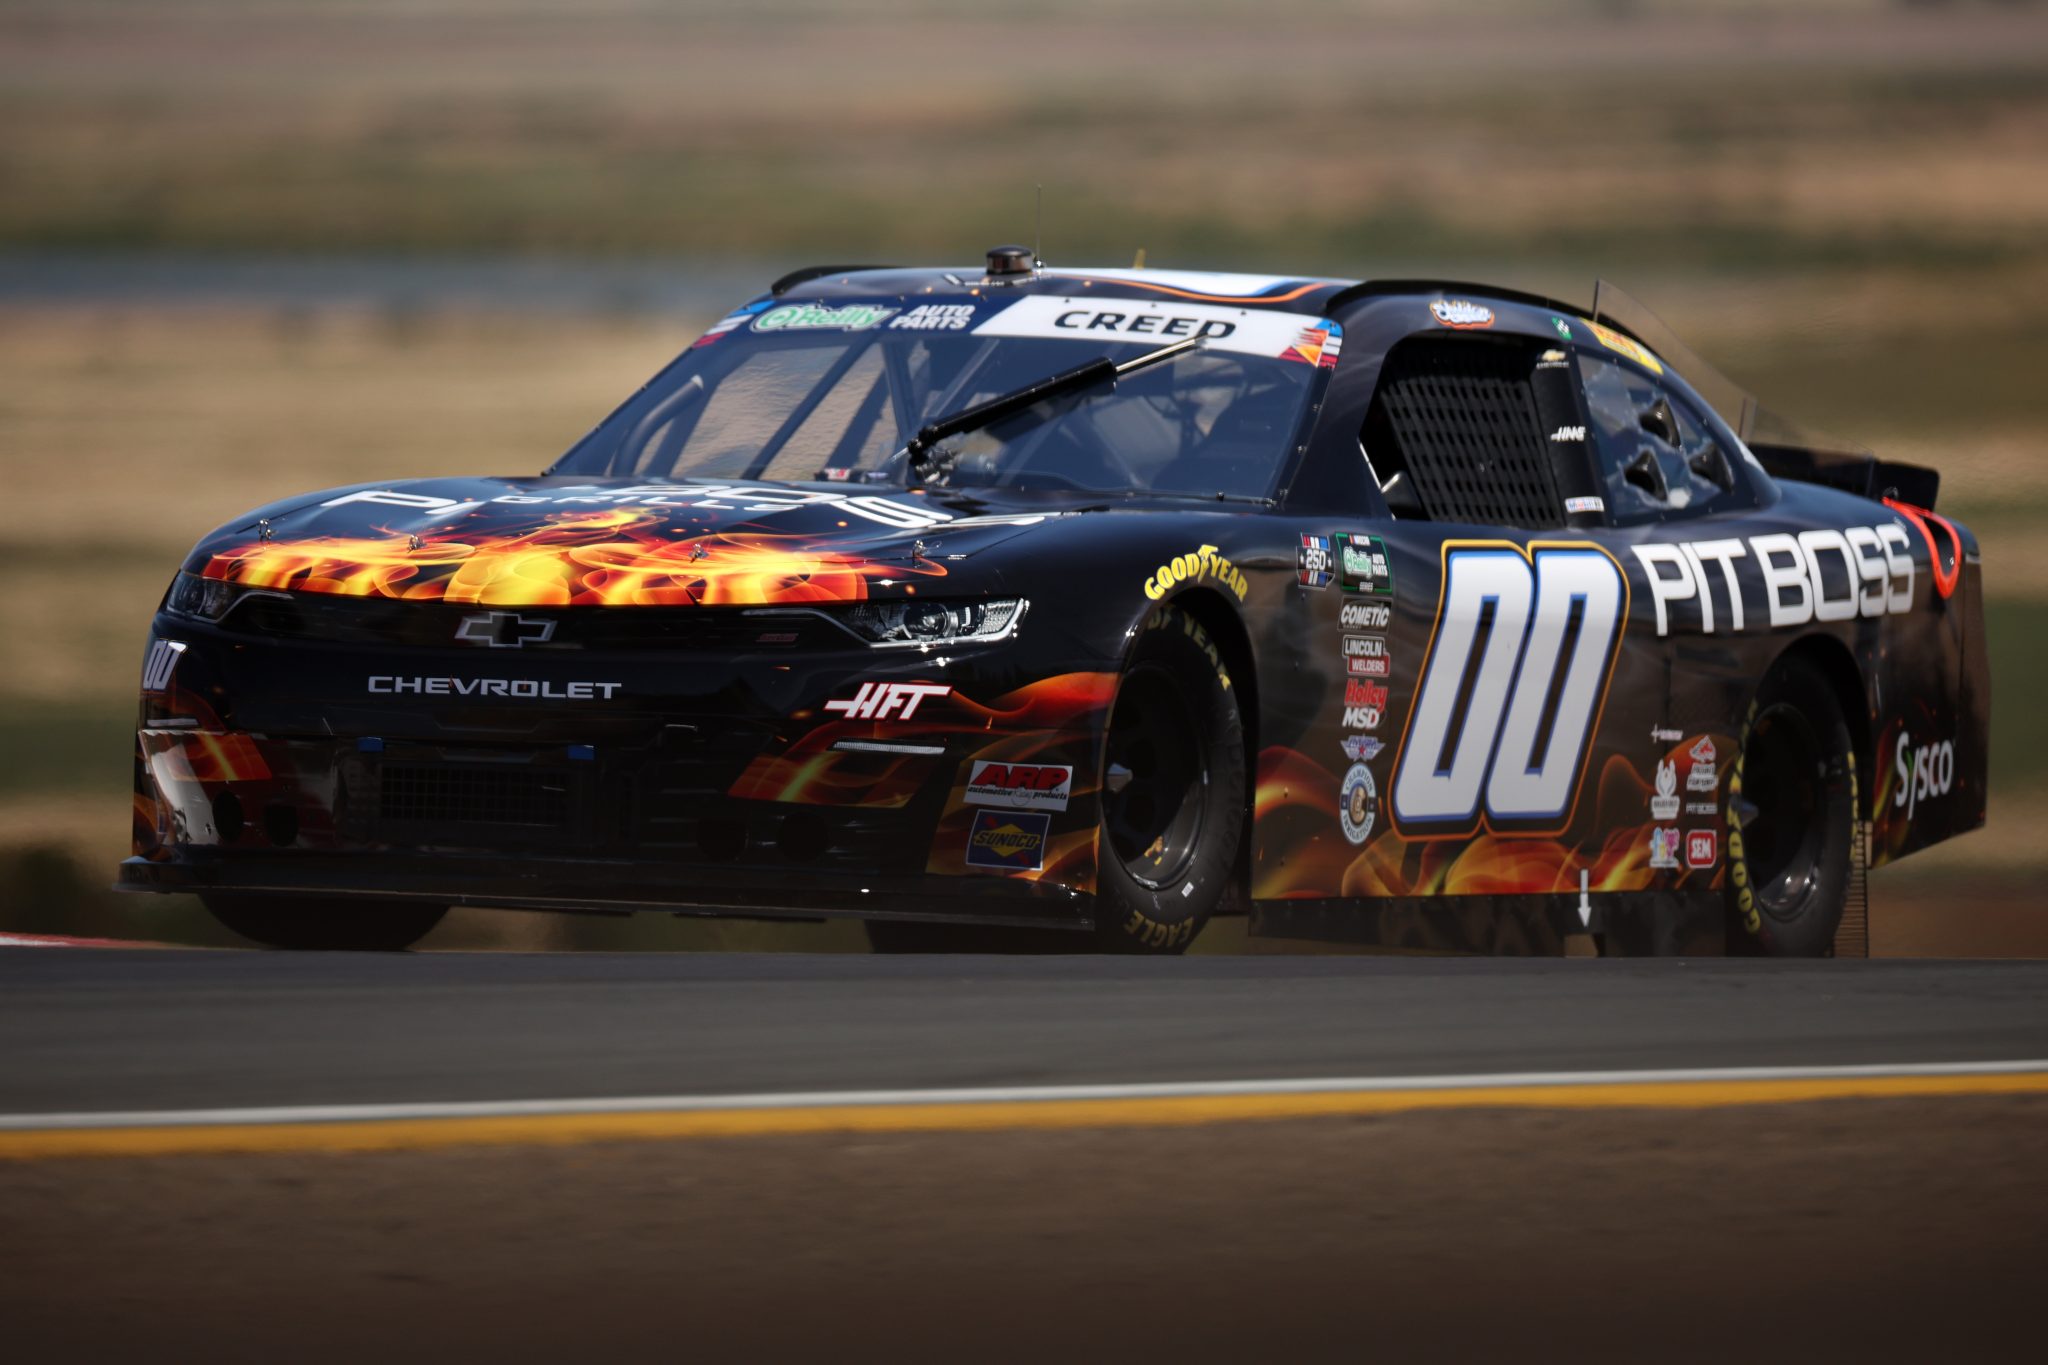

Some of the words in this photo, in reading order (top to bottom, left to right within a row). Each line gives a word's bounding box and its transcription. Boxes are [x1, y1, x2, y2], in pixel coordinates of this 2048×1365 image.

[888, 316, 971, 329] PARTS
[907, 305, 976, 317] AUTO
[1054, 310, 1237, 339] CREED
[1305, 548, 1327, 571] 250
[1144, 544, 1248, 603] GOODYEAR
[1631, 538, 1747, 636] PIT
[1749, 523, 1916, 627] BOSS
[1340, 604, 1391, 627] COMETIC
[1344, 638, 1383, 656] LINCOLN
[142, 639, 188, 690] 00
[1351, 658, 1386, 673] WELDERS
[368, 676, 622, 699] CHEVROLET
[1343, 677, 1388, 713] Holley
[1392, 549, 1623, 824] 00
[824, 682, 953, 720] HFT
[1341, 706, 1380, 730] MSD
[970, 763, 1070, 791] ARP
[1895, 730, 1954, 821] Sysco
[967, 786, 1012, 796] automotive
[975, 830, 1040, 848] SUNOCO
[1690, 837, 1712, 859] SEM
[1122, 908, 1195, 948] EAGLE
